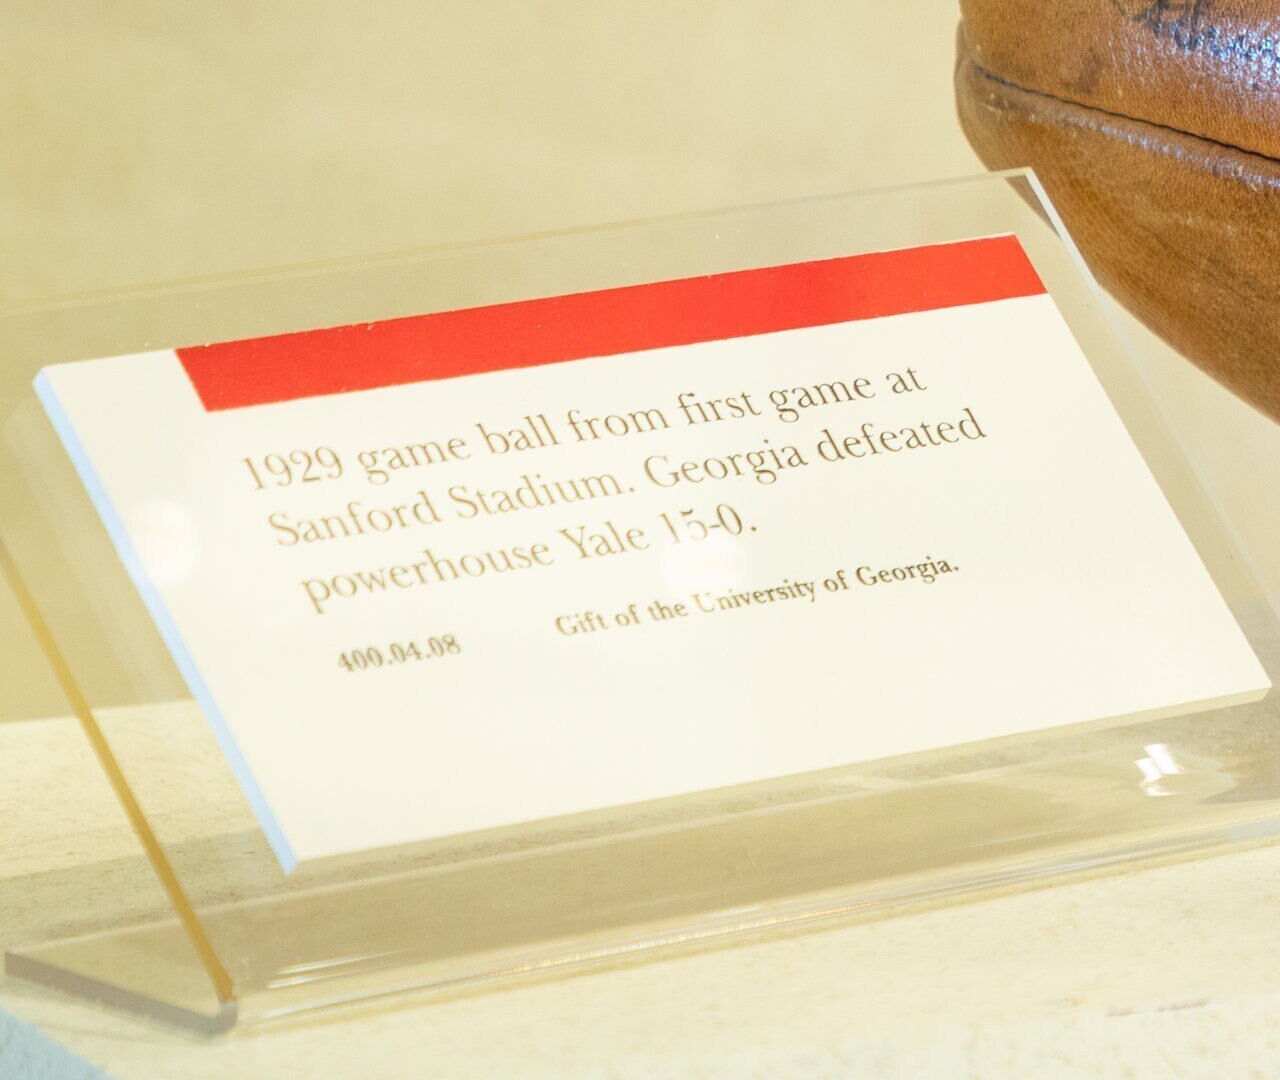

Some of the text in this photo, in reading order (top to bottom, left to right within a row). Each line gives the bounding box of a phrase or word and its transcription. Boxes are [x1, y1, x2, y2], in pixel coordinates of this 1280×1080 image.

[239, 365, 928, 492] 1929 game ball from first game at
[267, 407, 990, 549] Sanford Stadium. Georgia defeated
[301, 502, 759, 615] powerhouse Yale 15-0.
[337, 554, 960, 673] 400.04.08 Gift of the University of Georgia.
